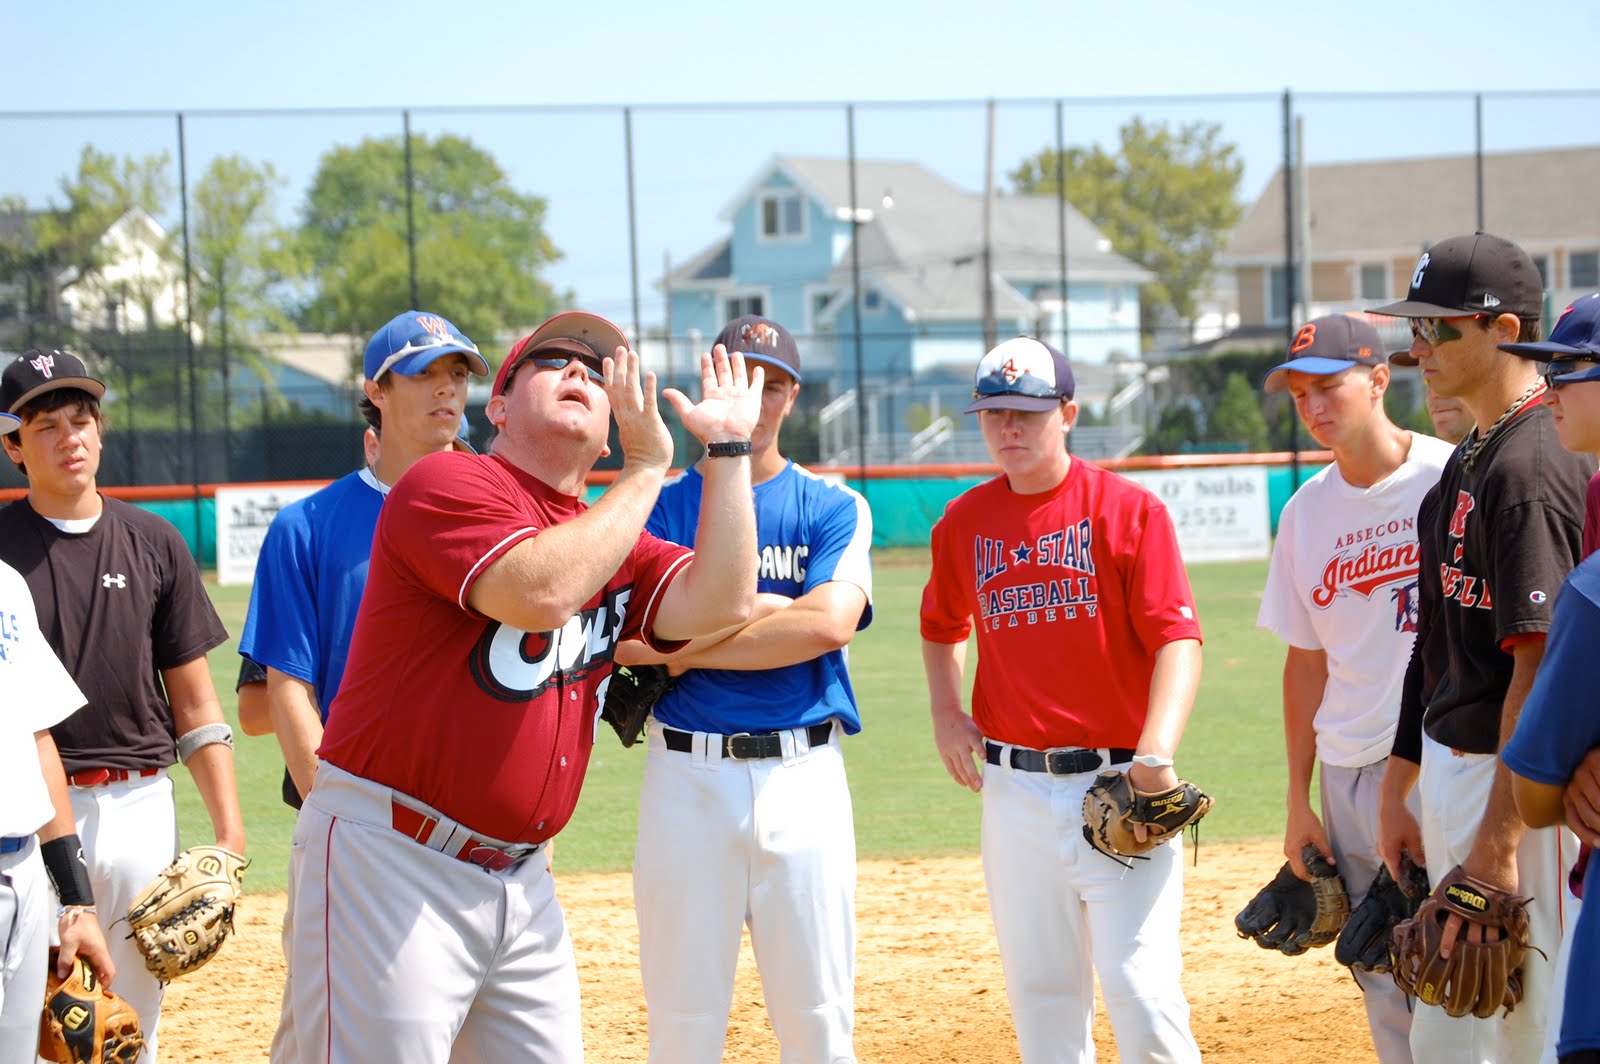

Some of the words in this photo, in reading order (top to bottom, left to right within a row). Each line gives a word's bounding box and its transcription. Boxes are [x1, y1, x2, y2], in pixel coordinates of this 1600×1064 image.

[416, 315, 453, 340] W
[1289, 323, 1316, 353] B
[1037, 516, 1095, 576] STAR
[1334, 517, 1415, 550] ABSECON
[978, 577, 1098, 619] BASEBALL
[1446, 885, 1488, 911] Wilson
